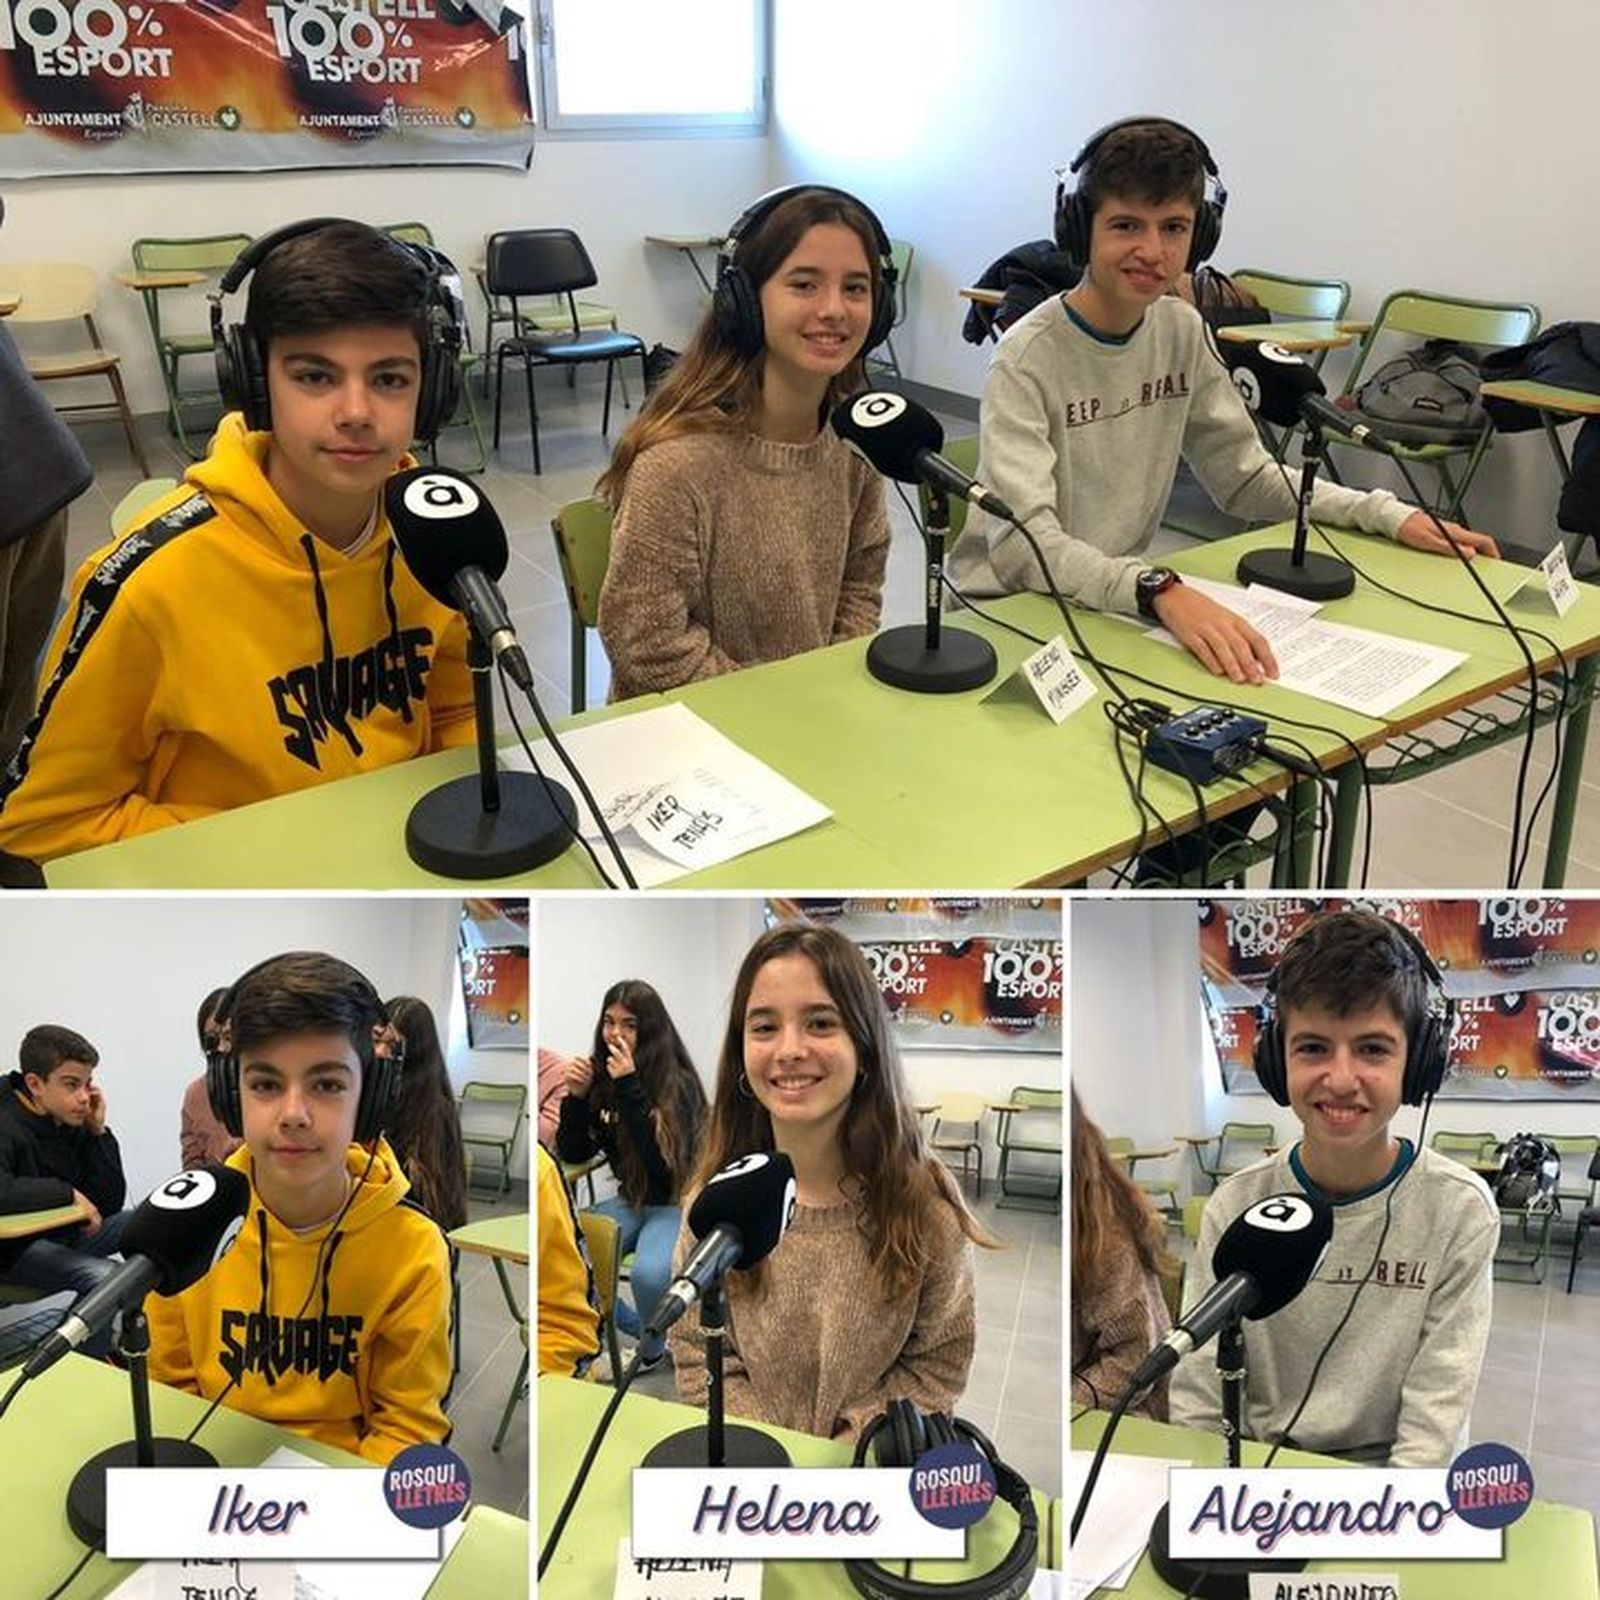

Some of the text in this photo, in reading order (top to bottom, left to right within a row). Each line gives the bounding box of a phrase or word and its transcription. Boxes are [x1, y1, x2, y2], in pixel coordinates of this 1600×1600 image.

[266, 4, 414, 58] 100%
[36, 47, 173, 77] ESPORT
[308, 57, 422, 83] ESPORT
[25, 113, 122, 126] AJUNTAMENT
[300, 115, 380, 126] AJUNTAMENT
[266, 626, 434, 770] SAVAGE
[1233, 899, 1306, 920] CASTELL
[1478, 897, 1566, 926] 100%
[1226, 918, 1293, 946] 100%
[1493, 918, 1567, 939] ESPORT
[1240, 938, 1291, 958] ESPOR
[863, 949, 926, 976] 00%
[878, 976, 928, 995] PORT
[219, 1310, 364, 1387] SAVAGE
